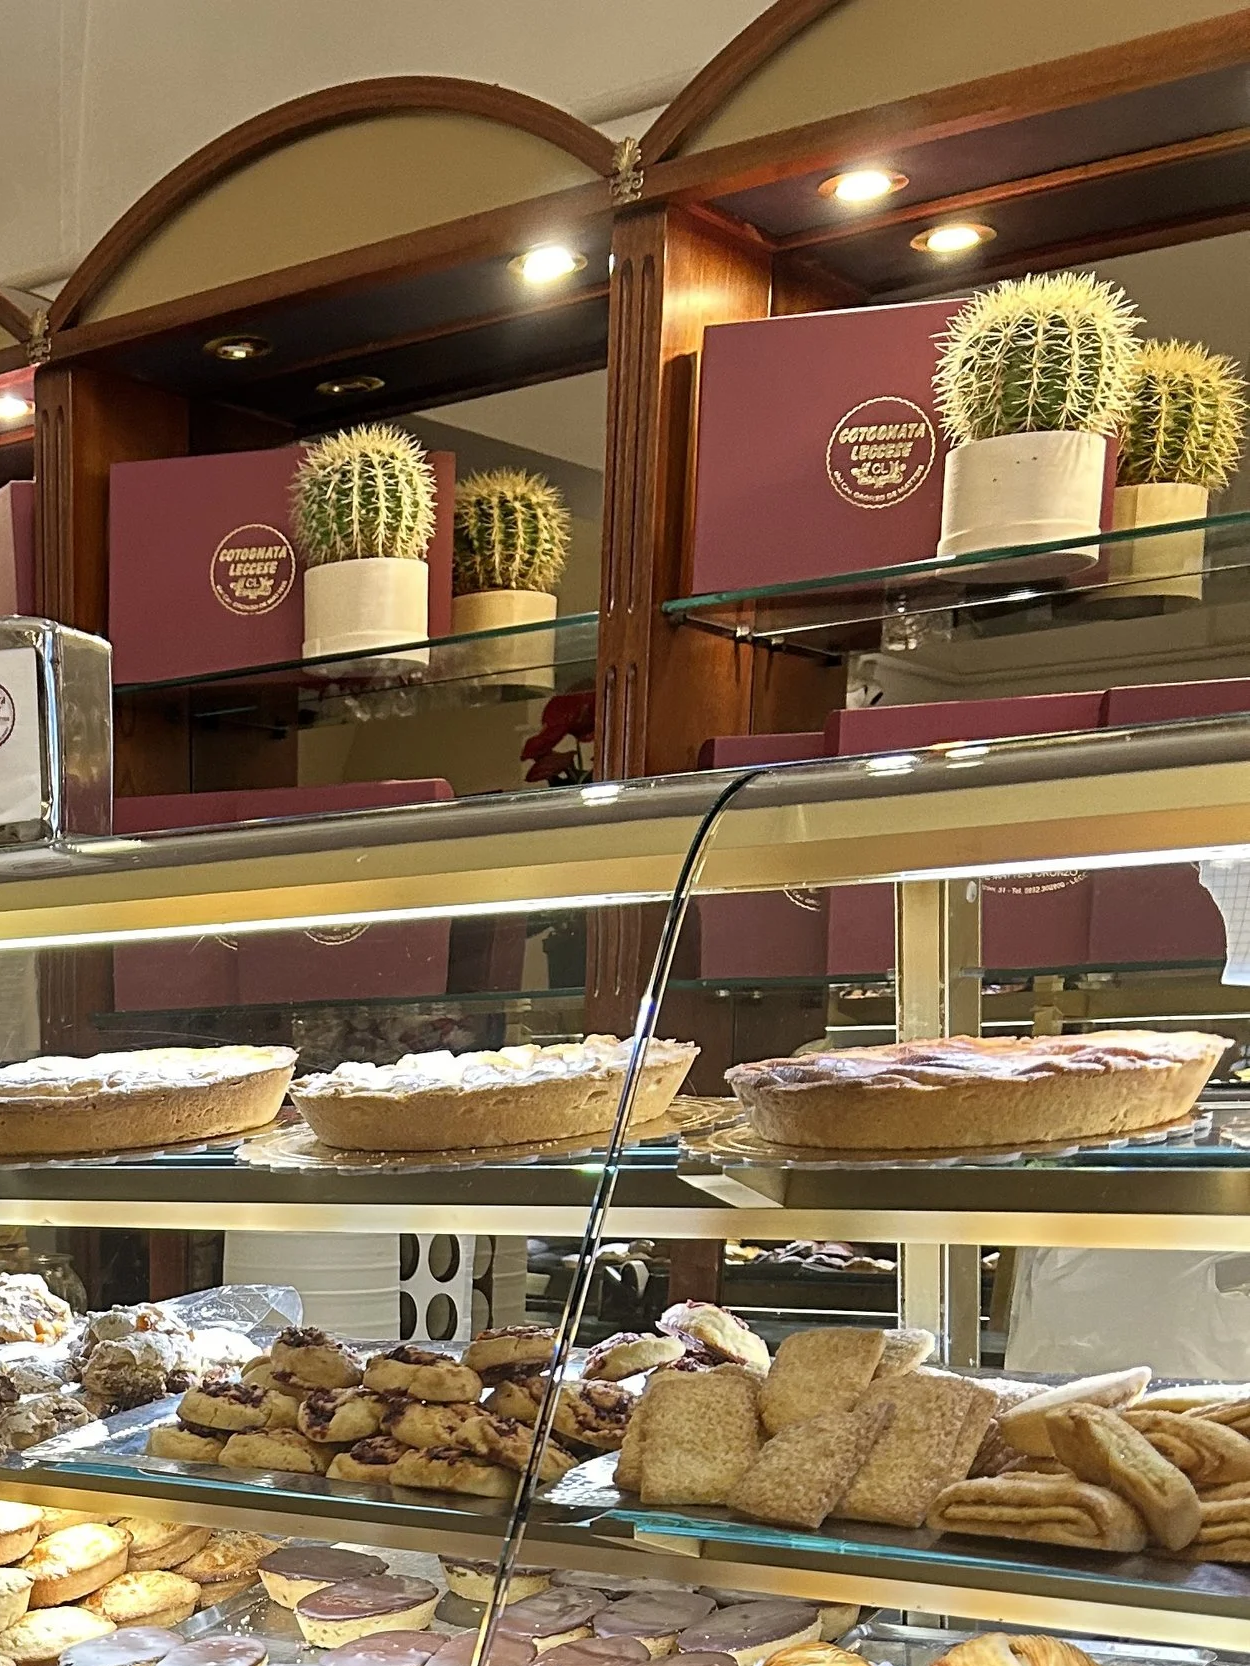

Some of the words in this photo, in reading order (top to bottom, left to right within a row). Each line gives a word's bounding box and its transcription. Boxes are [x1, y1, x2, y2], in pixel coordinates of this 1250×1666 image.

[838, 422, 926, 444] COTOGNATA
[851, 442, 914, 461] LECCESE
[219, 545, 288, 562] COTOGNATA
[229, 561, 279, 576] LECCESE
